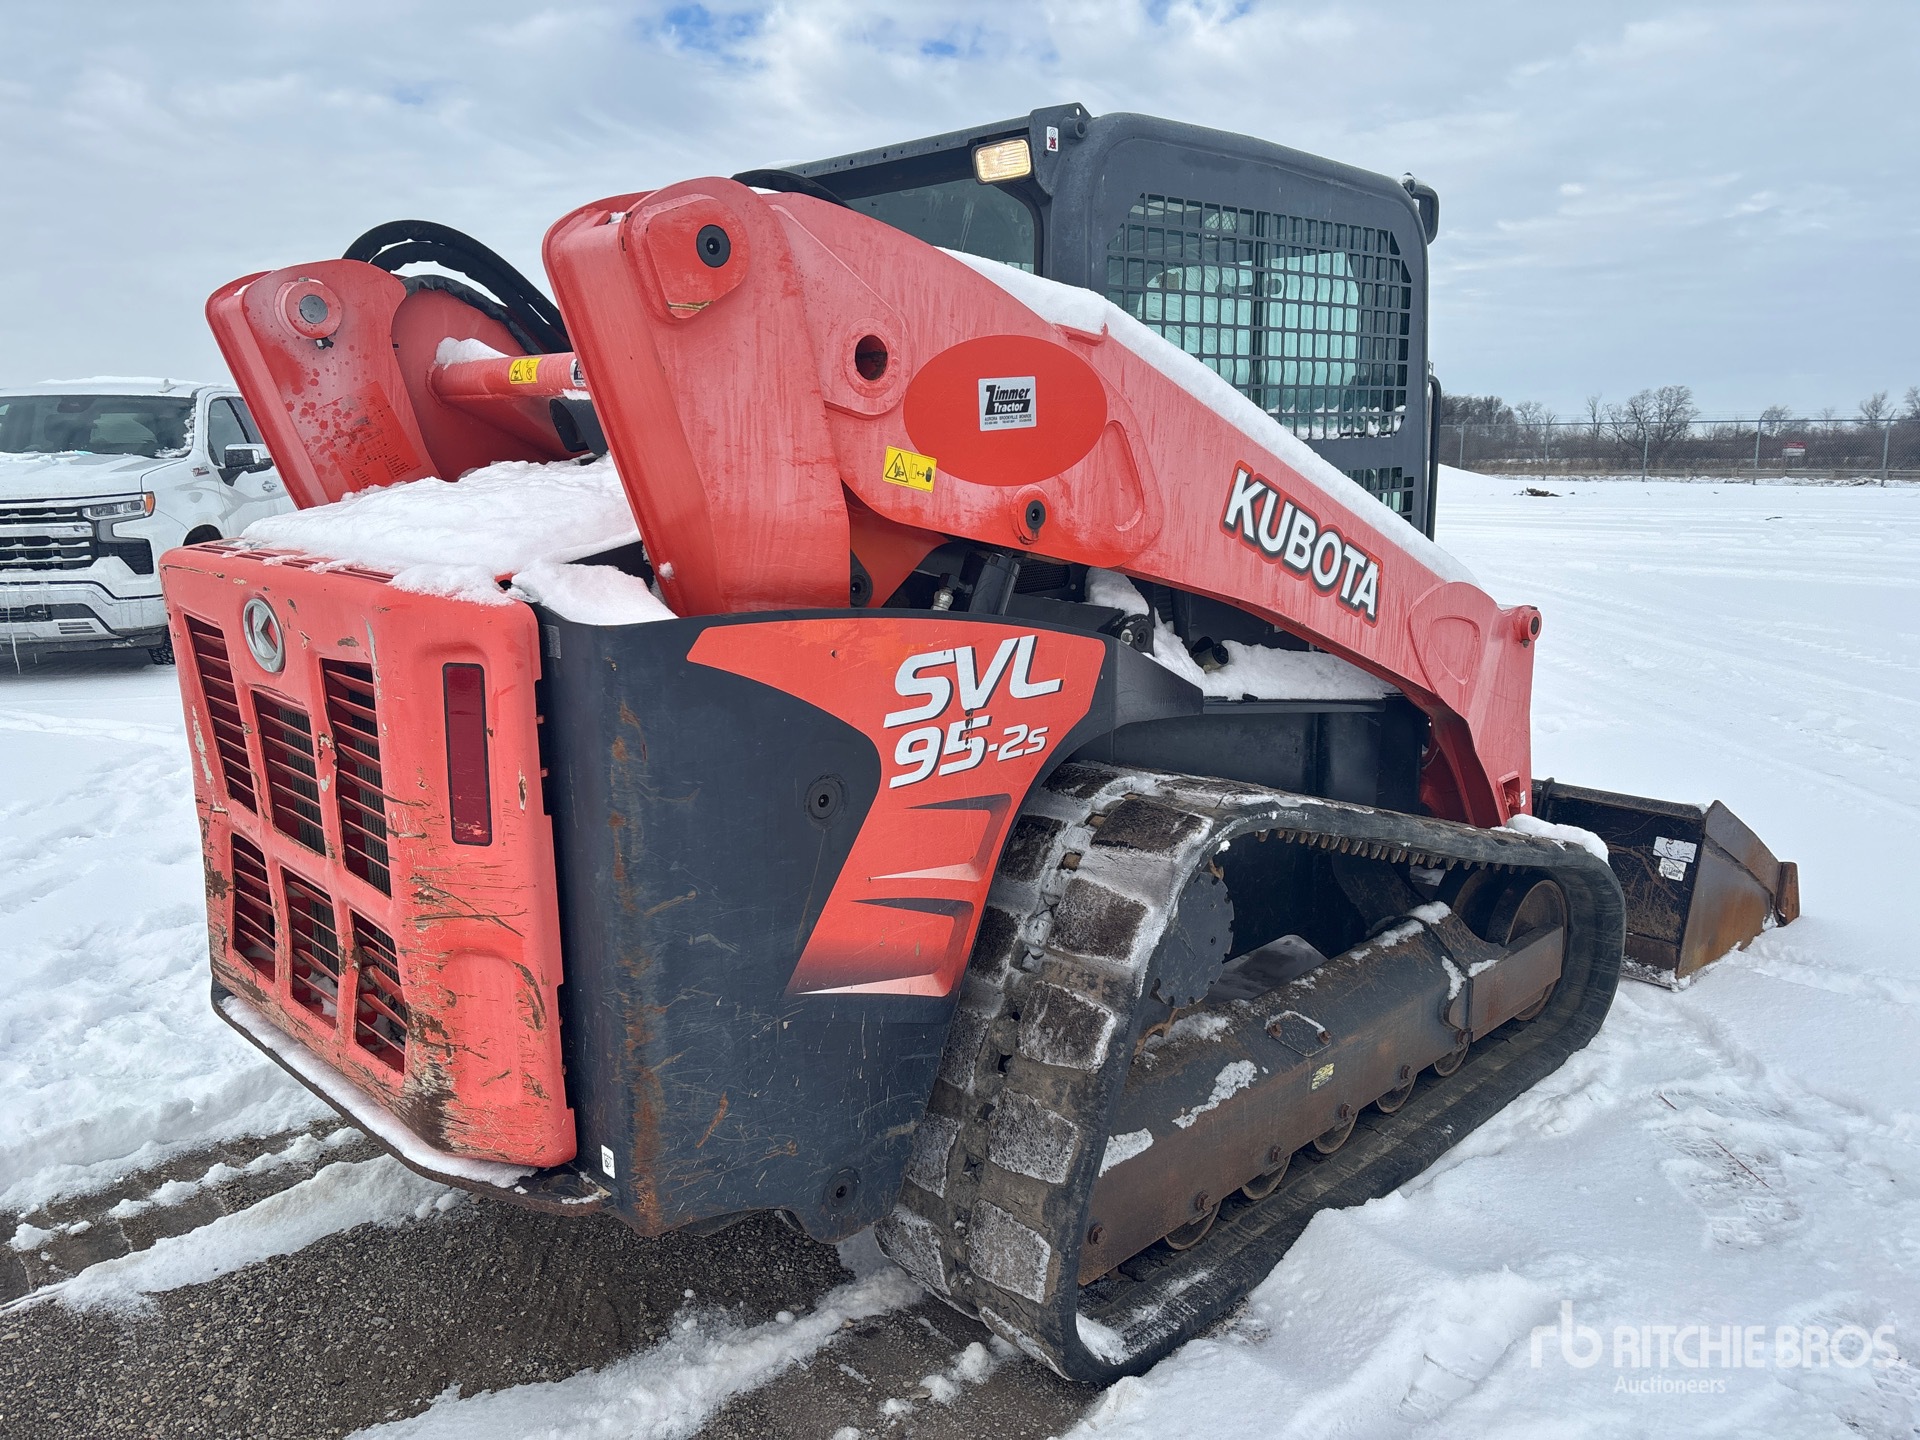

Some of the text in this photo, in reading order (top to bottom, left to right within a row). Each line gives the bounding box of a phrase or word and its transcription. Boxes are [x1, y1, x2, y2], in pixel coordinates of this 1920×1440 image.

[994, 402, 1024, 413] Tractor
[1224, 468, 1379, 618] KUBOTA
[883, 635, 1063, 728] SVL
